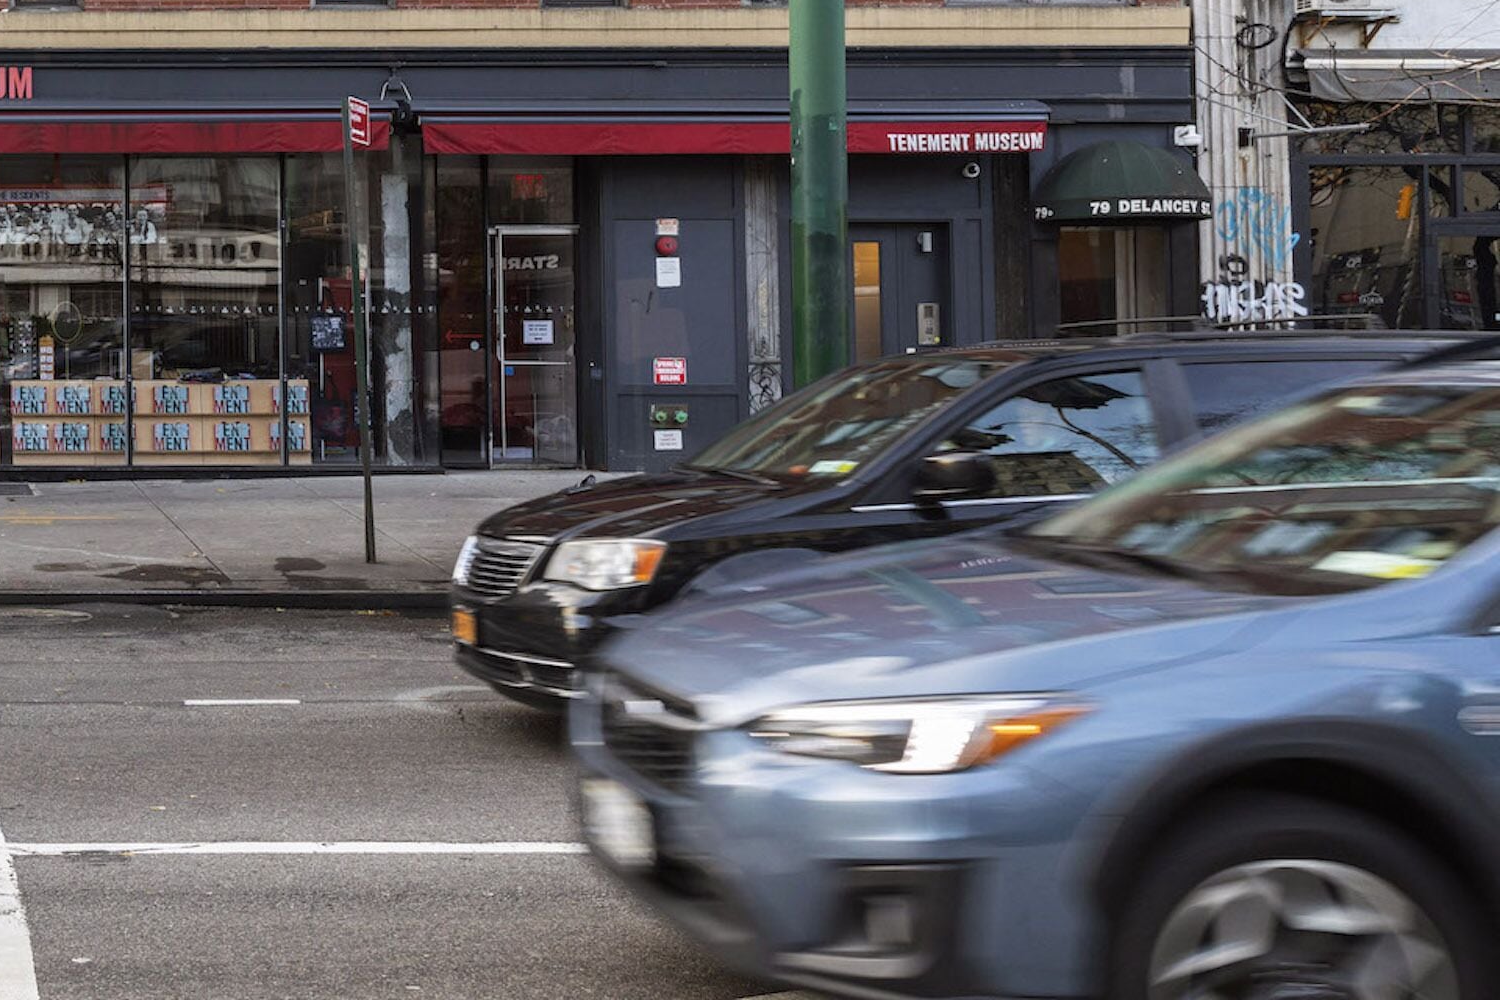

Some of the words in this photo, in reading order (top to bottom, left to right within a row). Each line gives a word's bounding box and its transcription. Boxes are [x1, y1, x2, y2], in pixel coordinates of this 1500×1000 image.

[887, 133, 970, 152] TENEMENT
[974, 132, 1044, 151] MUSEUM
[1090, 201, 1110, 215] 79
[1119, 199, 1198, 214] DELANCEY
[101, 400, 130, 414] MEN
[101, 437, 130, 451] MEN
